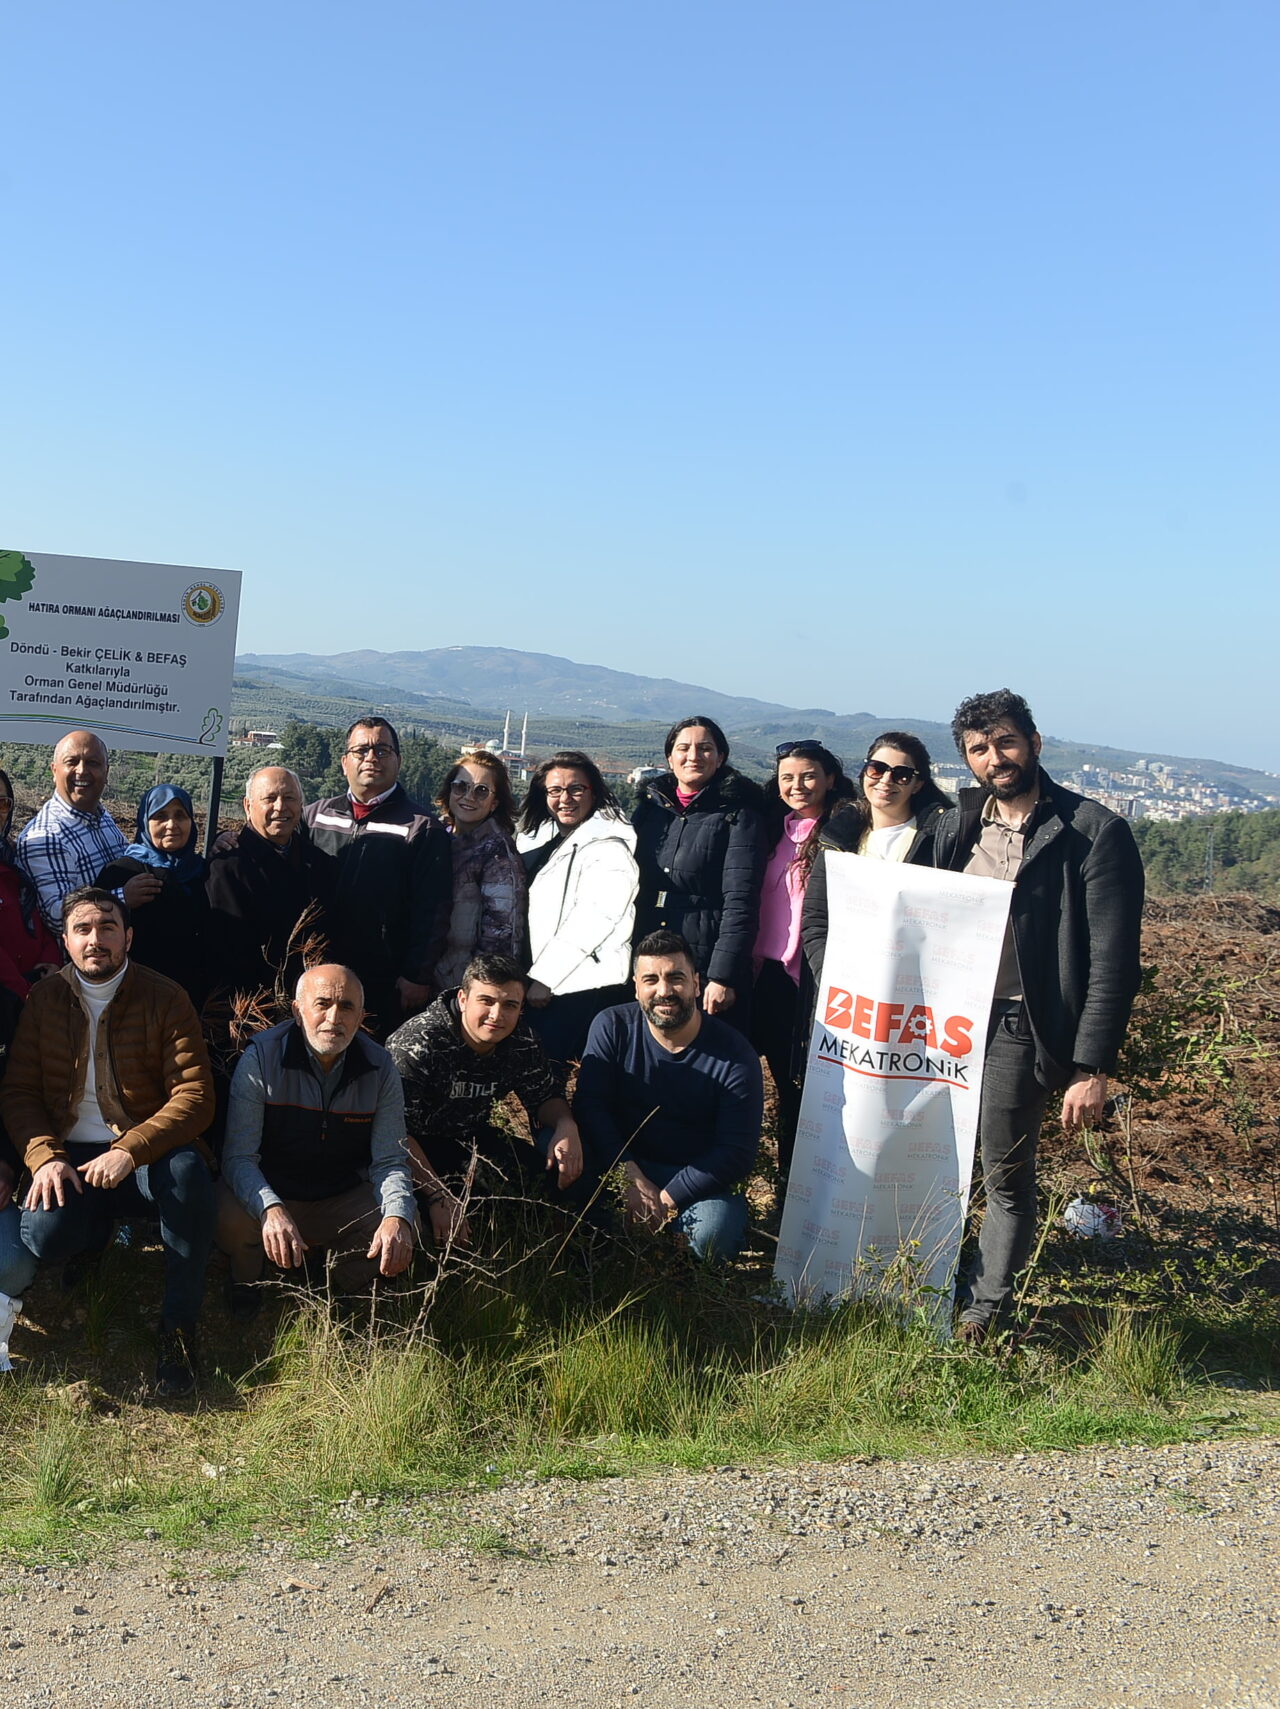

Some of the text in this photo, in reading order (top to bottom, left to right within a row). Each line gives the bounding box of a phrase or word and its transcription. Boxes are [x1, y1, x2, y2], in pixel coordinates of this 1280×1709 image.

[28, 602, 181, 623] HATIRA ORMANI AĞAÇLANDIRILMASI
[10, 642, 50, 655] Döndü
[61, 646, 92, 659] Bekir
[95, 647, 132, 661] ÇELİK
[135, 652, 144, 662] &
[147, 652, 187, 668] BEFAŞ
[66, 662, 131, 679] Katkılarıyla
[24, 675, 169, 698] Orman Genel Müdürlüğü
[9, 690, 181, 714] Tarafından Ağaçlandırılmıştır.
